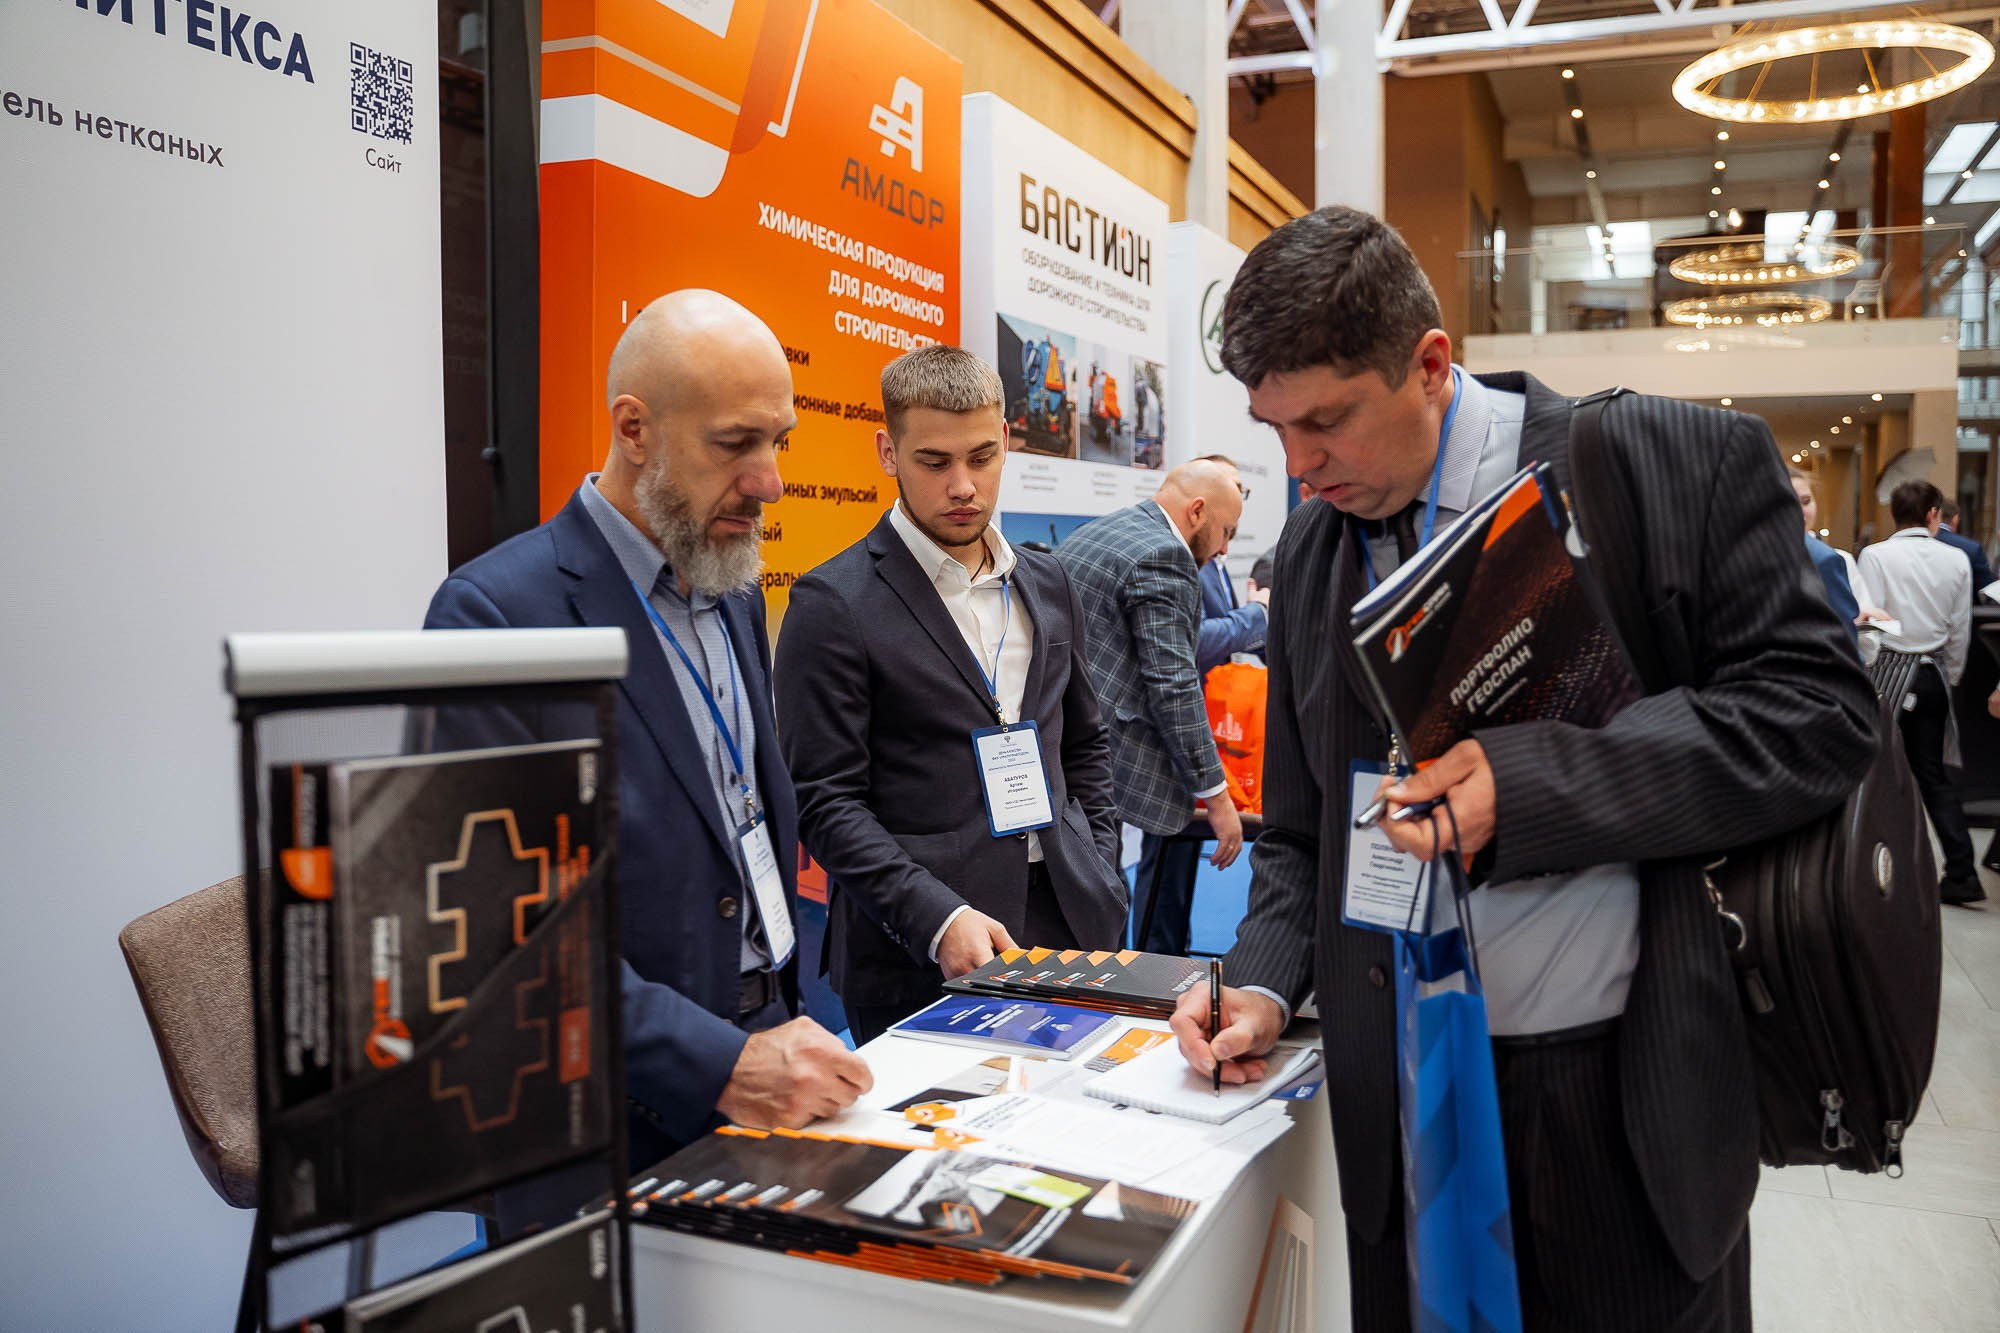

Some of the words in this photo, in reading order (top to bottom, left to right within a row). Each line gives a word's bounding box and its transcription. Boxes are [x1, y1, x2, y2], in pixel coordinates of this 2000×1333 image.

[0, 89, 63, 127] ель
[75, 109, 224, 167] нетканых
[366, 148, 402, 174] Сайт
[841, 157, 945, 230] АМДОР
[758, 201, 863, 264] ХИМИЧЕСКАЯ
[866, 245, 944, 293] ПРОДУКЦИЯ
[1020, 172, 1151, 286] БАСТИОН
[829, 270, 859, 300] ДЛЯ
[862, 281, 944, 327] ДОРОЖНОГО
[1027, 276, 1083, 310] ДОРОЖНОГО
[781, 345, 810, 367] вки
[835, 310, 942, 351] СТРОИТЕЛЬСТ
[820, 485, 878, 506] эмульсий
[758, 521, 782, 542] ый
[1450, 617, 1535, 706] ПОРТФОЛИО
[1466, 646, 1533, 714] ГЕОСПАН
